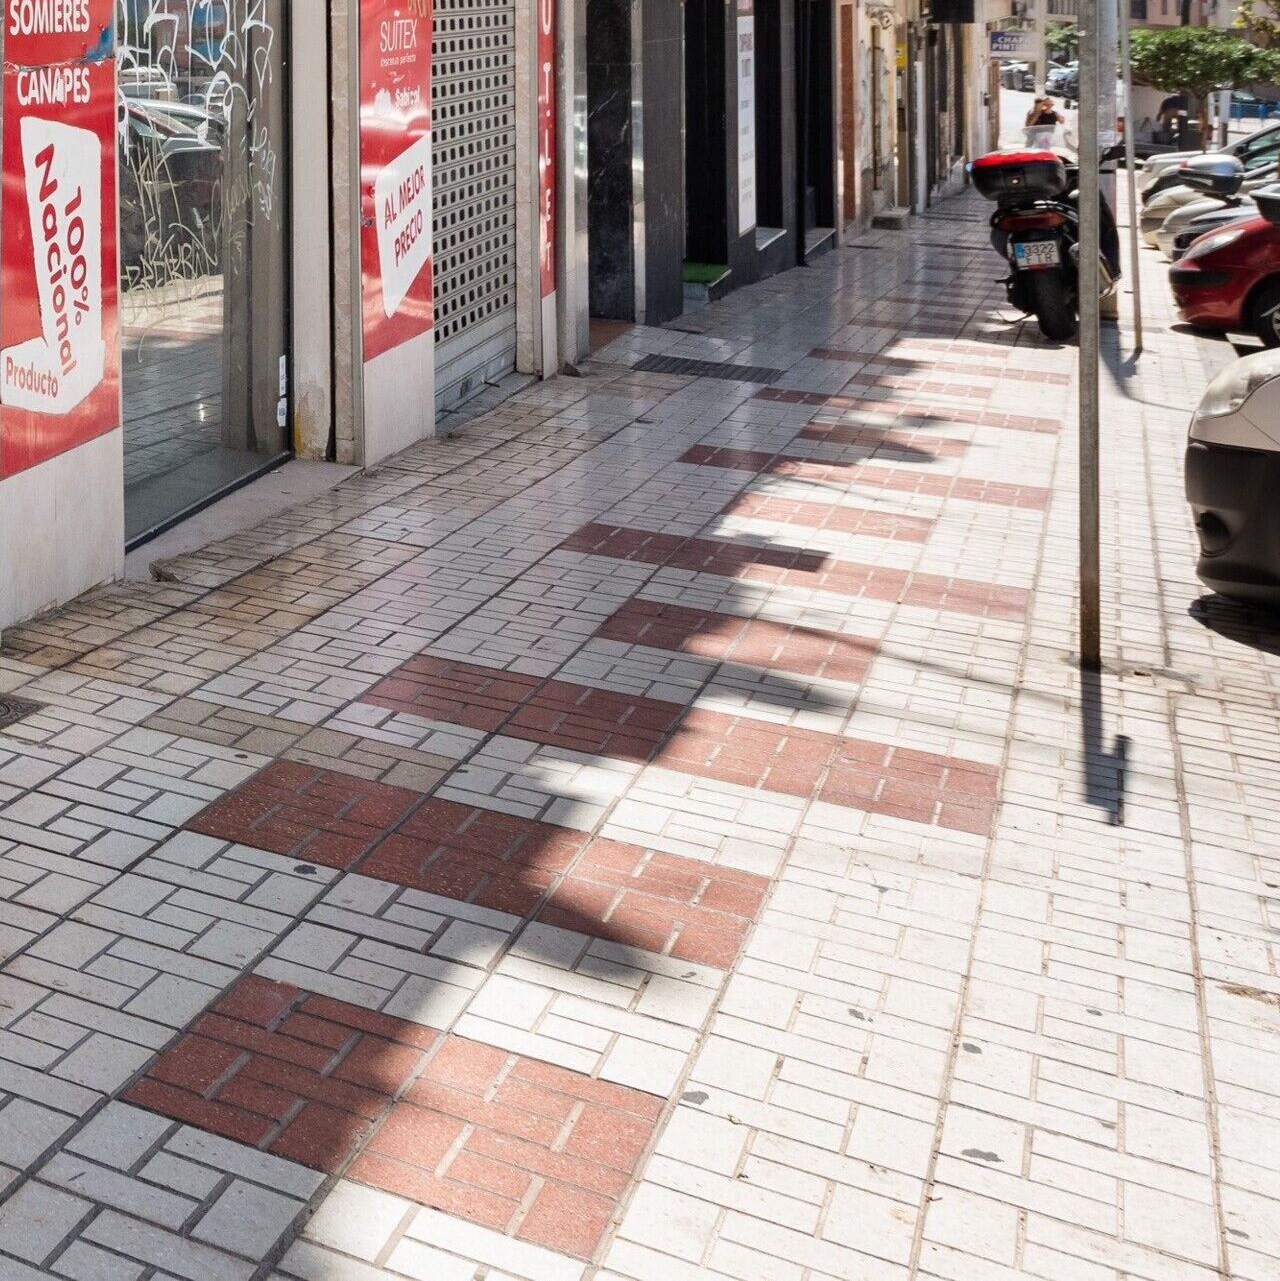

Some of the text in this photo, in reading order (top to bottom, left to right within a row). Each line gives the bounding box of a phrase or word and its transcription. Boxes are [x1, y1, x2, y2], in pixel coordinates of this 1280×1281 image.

[380, 19, 417, 53] SUITEX
[17, 67, 91, 106] CANAPES
[384, 165, 426, 230] AL MEJOR
[35, 143, 77, 376] Nacional
[65, 185, 90, 326] 100%
[394, 209, 423, 268] PRECIO
[5, 356, 59, 399] Producto
